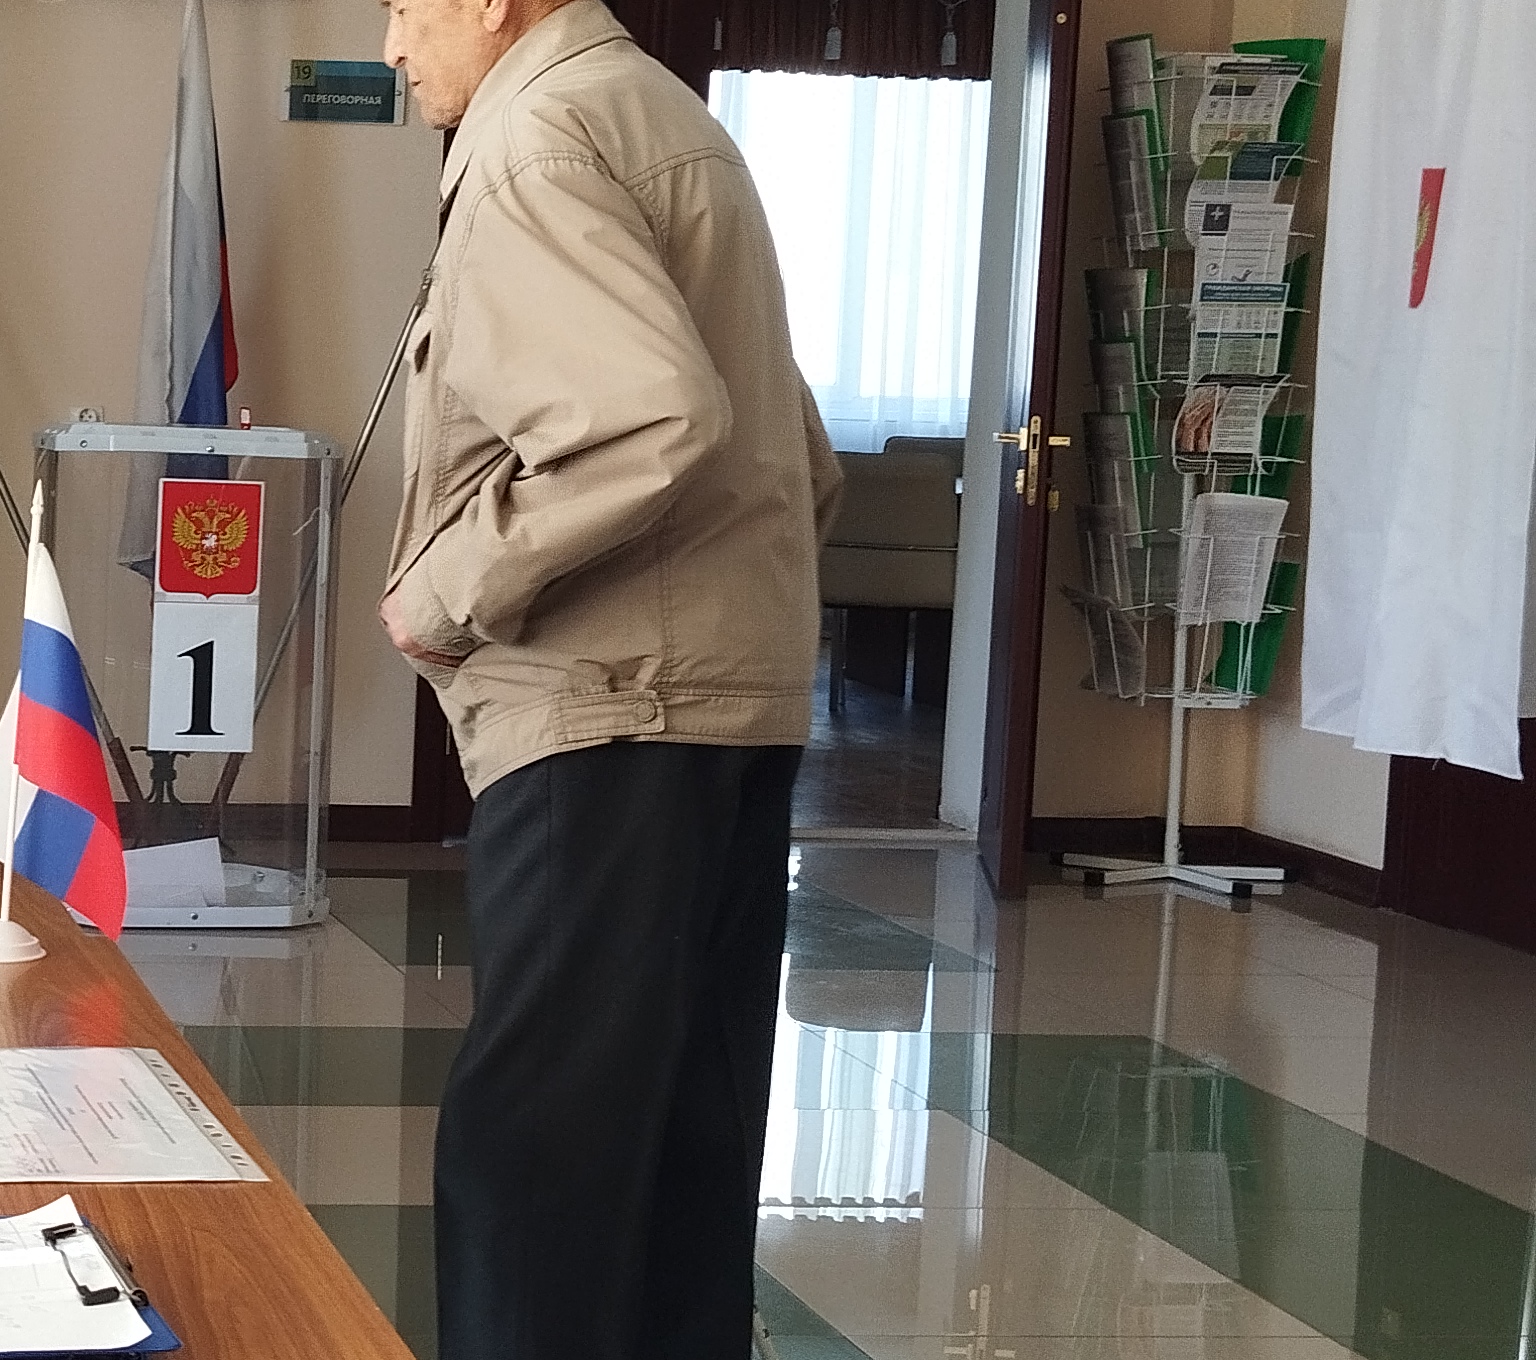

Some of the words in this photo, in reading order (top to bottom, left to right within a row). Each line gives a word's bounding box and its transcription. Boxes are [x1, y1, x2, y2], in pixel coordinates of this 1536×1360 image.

[295, 65, 312, 80] 19
[303, 94, 382, 105] ПЕРЕГОВОРНАЯ
[174, 640, 225, 736] 1
